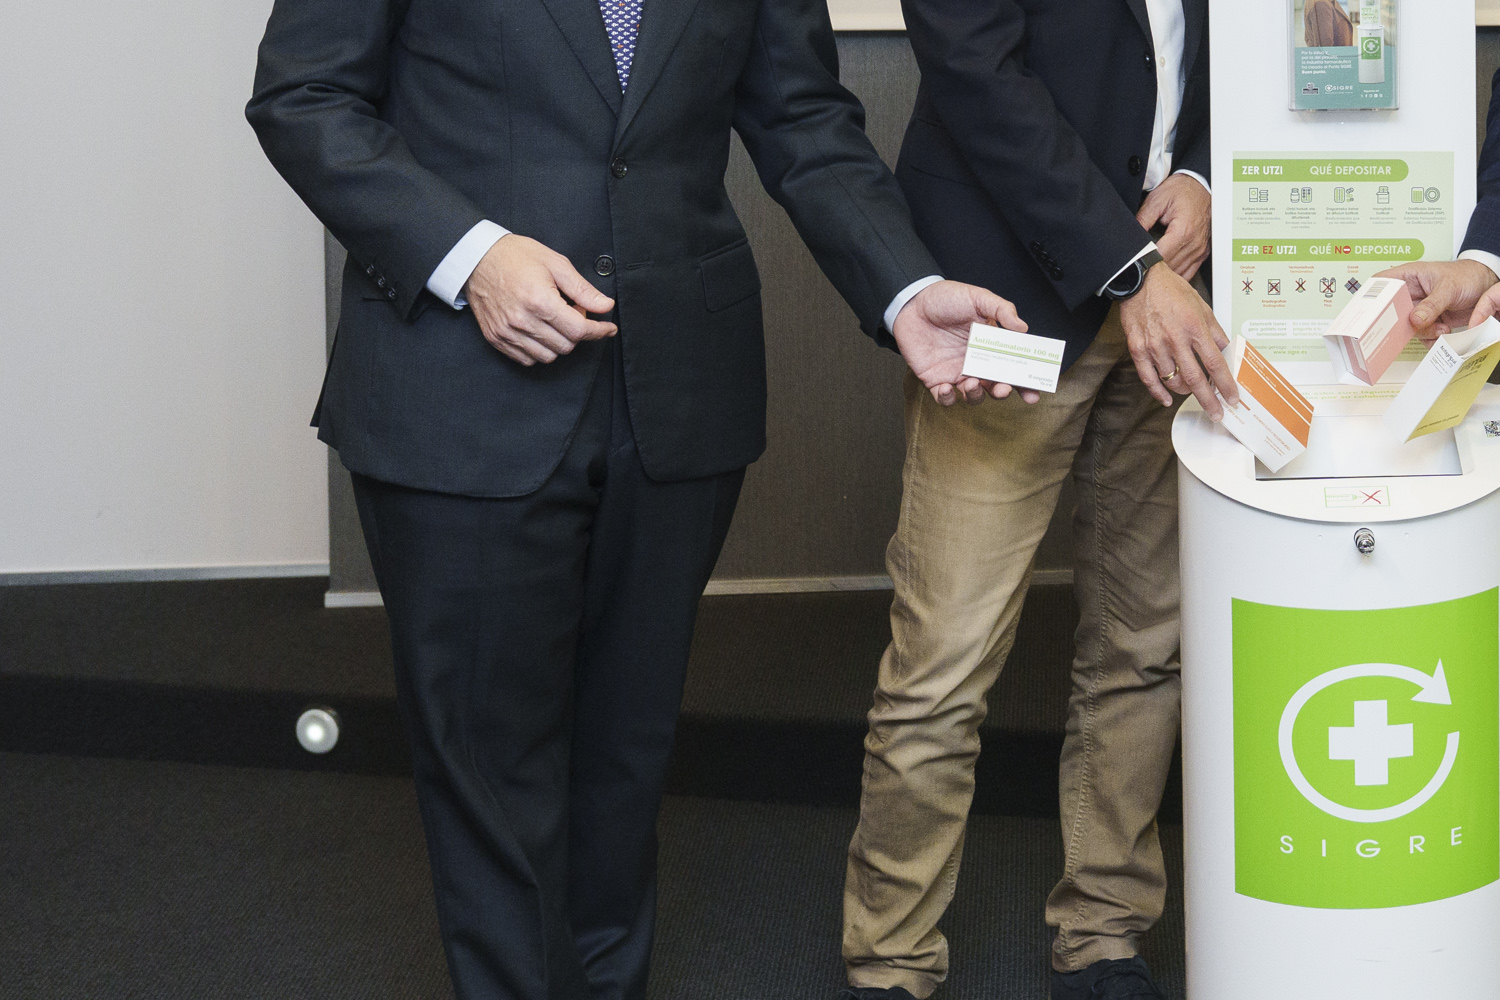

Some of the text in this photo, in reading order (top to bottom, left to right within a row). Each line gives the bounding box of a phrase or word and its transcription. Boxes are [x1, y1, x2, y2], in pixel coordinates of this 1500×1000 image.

[1242, 163, 1392, 175] ZER UTZI QUÉ DEPOSITAR
[1241, 246, 1259, 255] ZER
[1262, 246, 1273, 255] EZ
[1276, 246, 1297, 255] UTZI
[1309, 243, 1332, 255] QUÉ
[1355, 246, 1411, 255] DEPOSITAR
[972, 336, 1060, 360] Antiinflamatorio 100 mg
[1280, 826, 1462, 858] SIGRE
